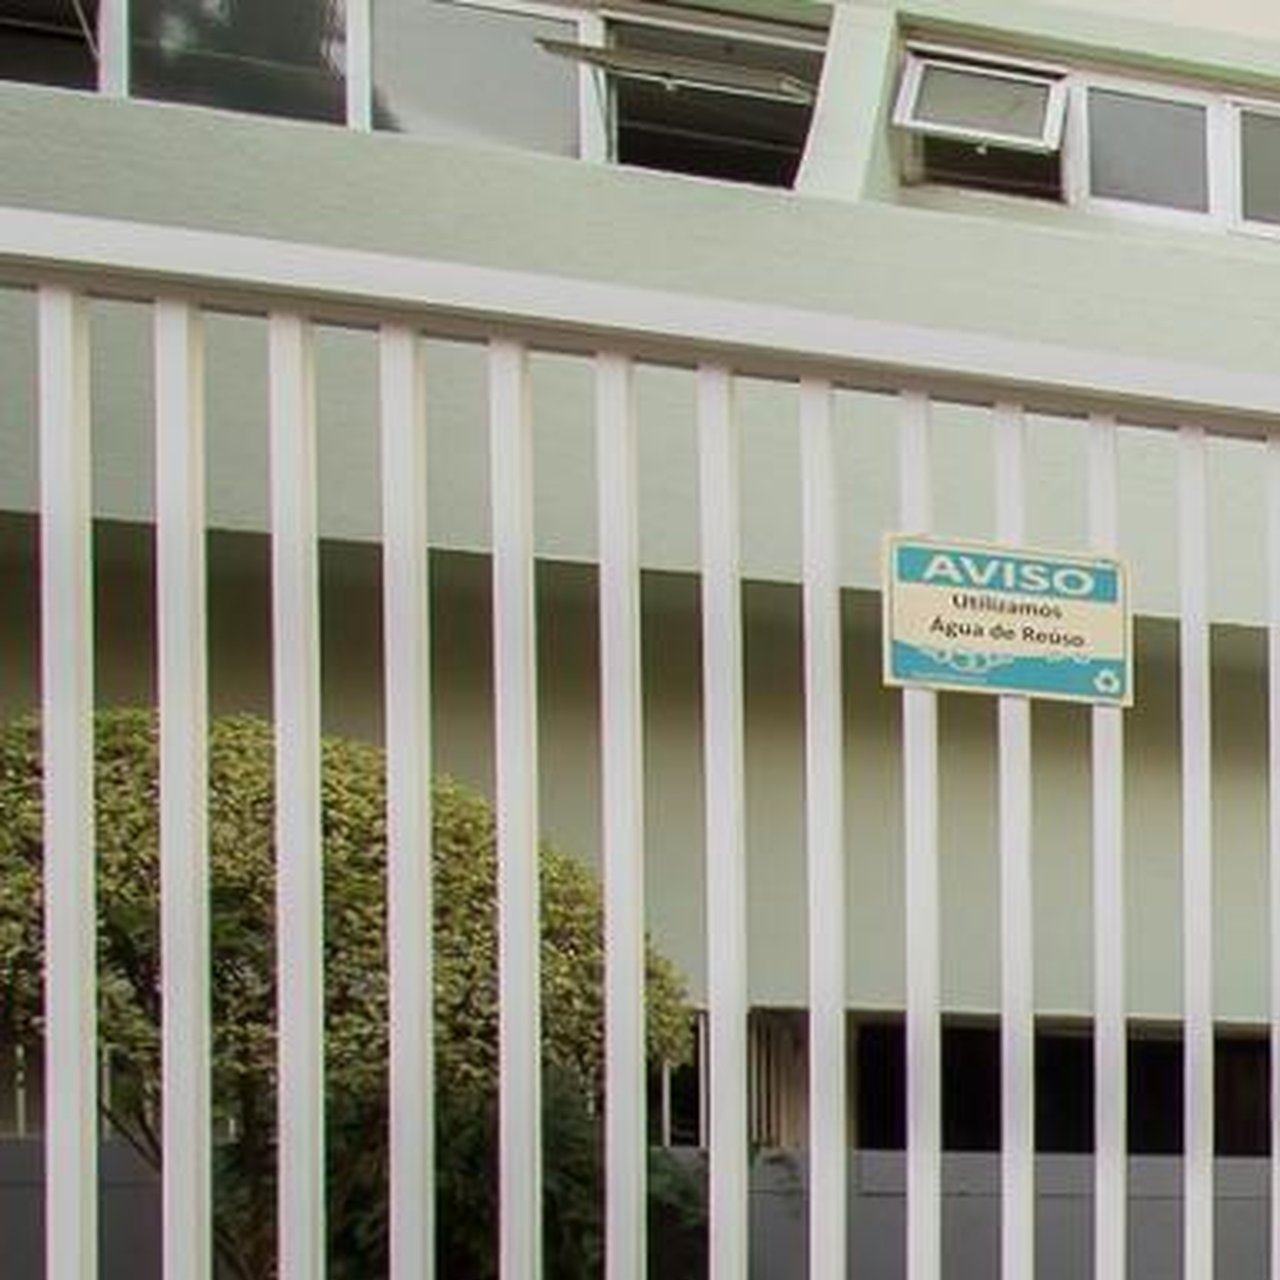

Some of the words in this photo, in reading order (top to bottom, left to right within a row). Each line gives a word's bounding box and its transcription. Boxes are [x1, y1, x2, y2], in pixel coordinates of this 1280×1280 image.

[923, 553, 1095, 597] AVISO
[951, 594, 1063, 620] Utilizamos
[989, 623, 1017, 641] de
